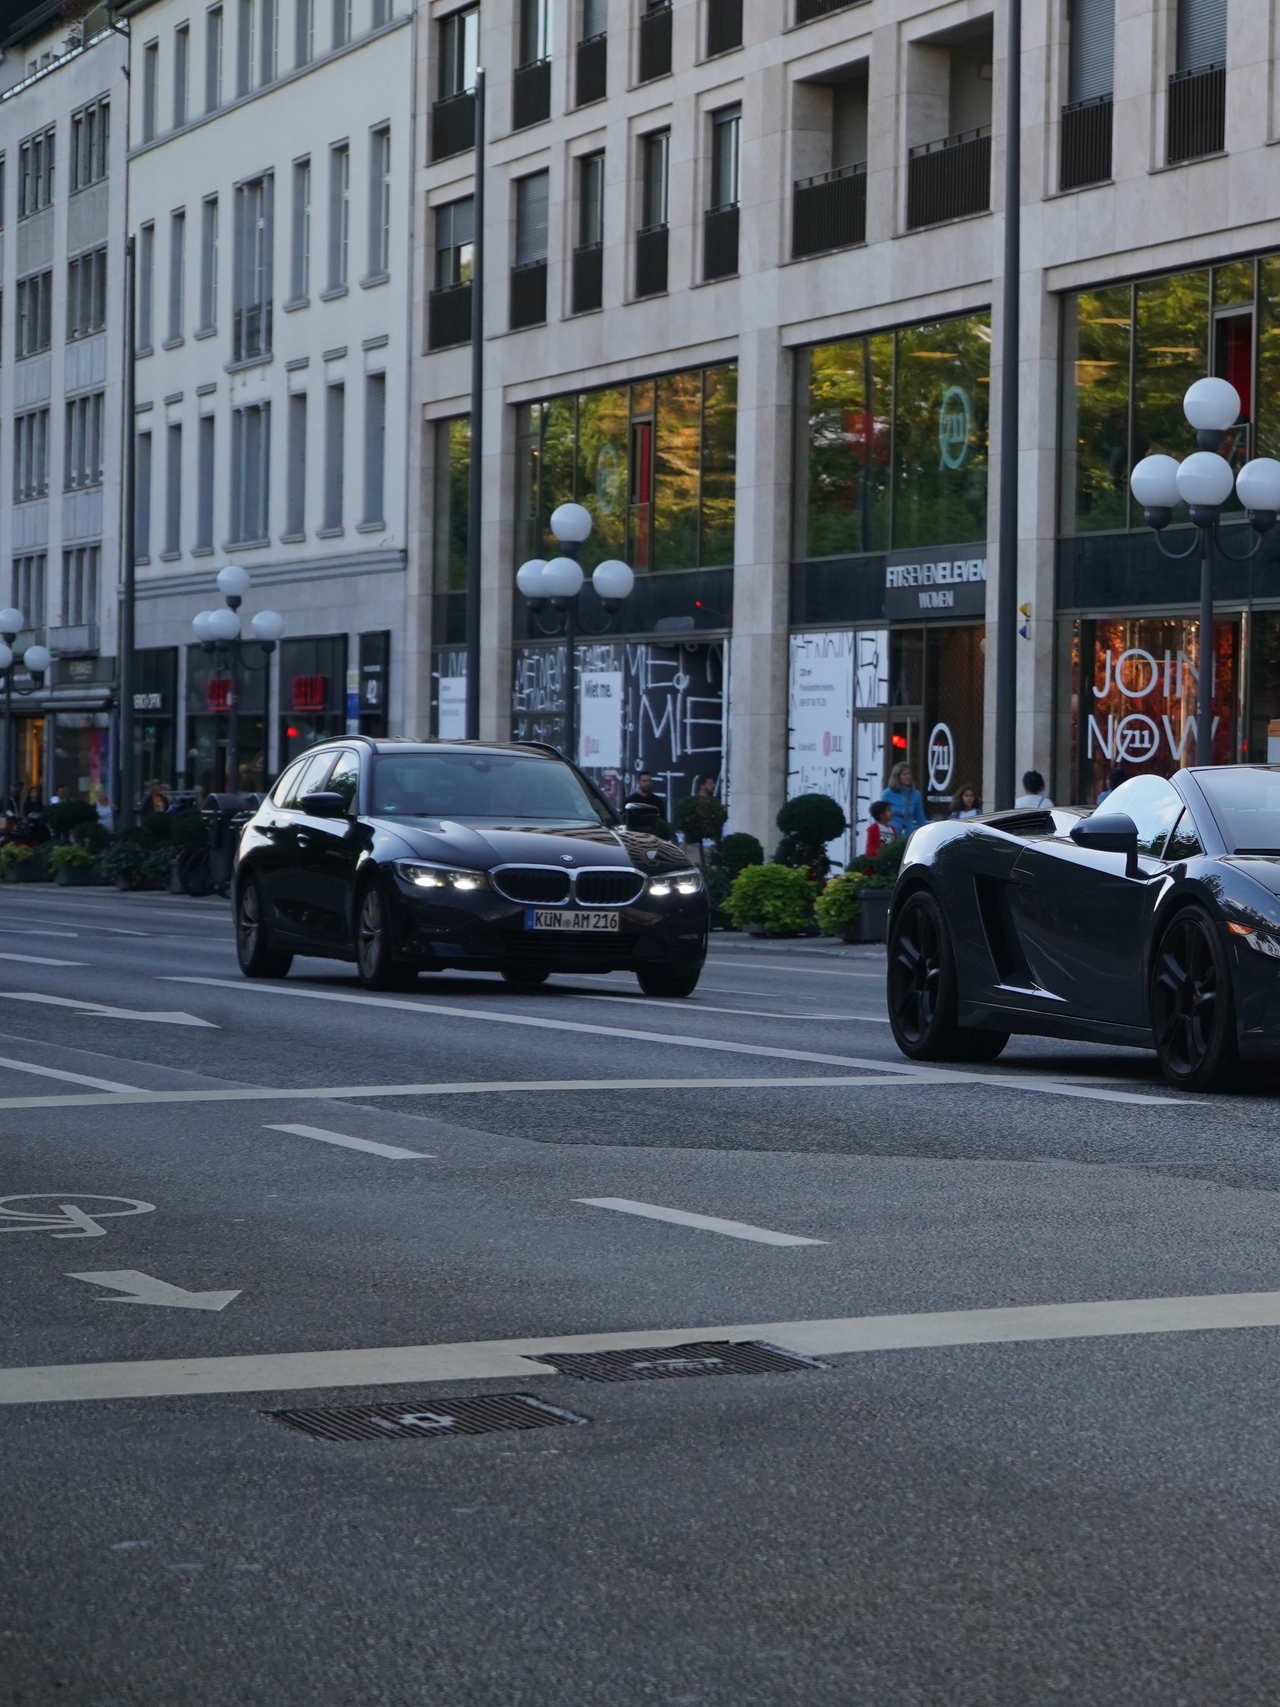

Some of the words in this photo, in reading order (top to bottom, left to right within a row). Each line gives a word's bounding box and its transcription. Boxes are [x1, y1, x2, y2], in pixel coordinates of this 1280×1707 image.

[886, 559, 987, 588] FITSEVENELEVEN
[918, 591, 954, 608] WOMEN
[1092, 648, 1216, 698] JOIN
[1088, 714, 1220, 763] NOW
[572, 914, 590, 928] AM
[593, 914, 617, 929] 216
